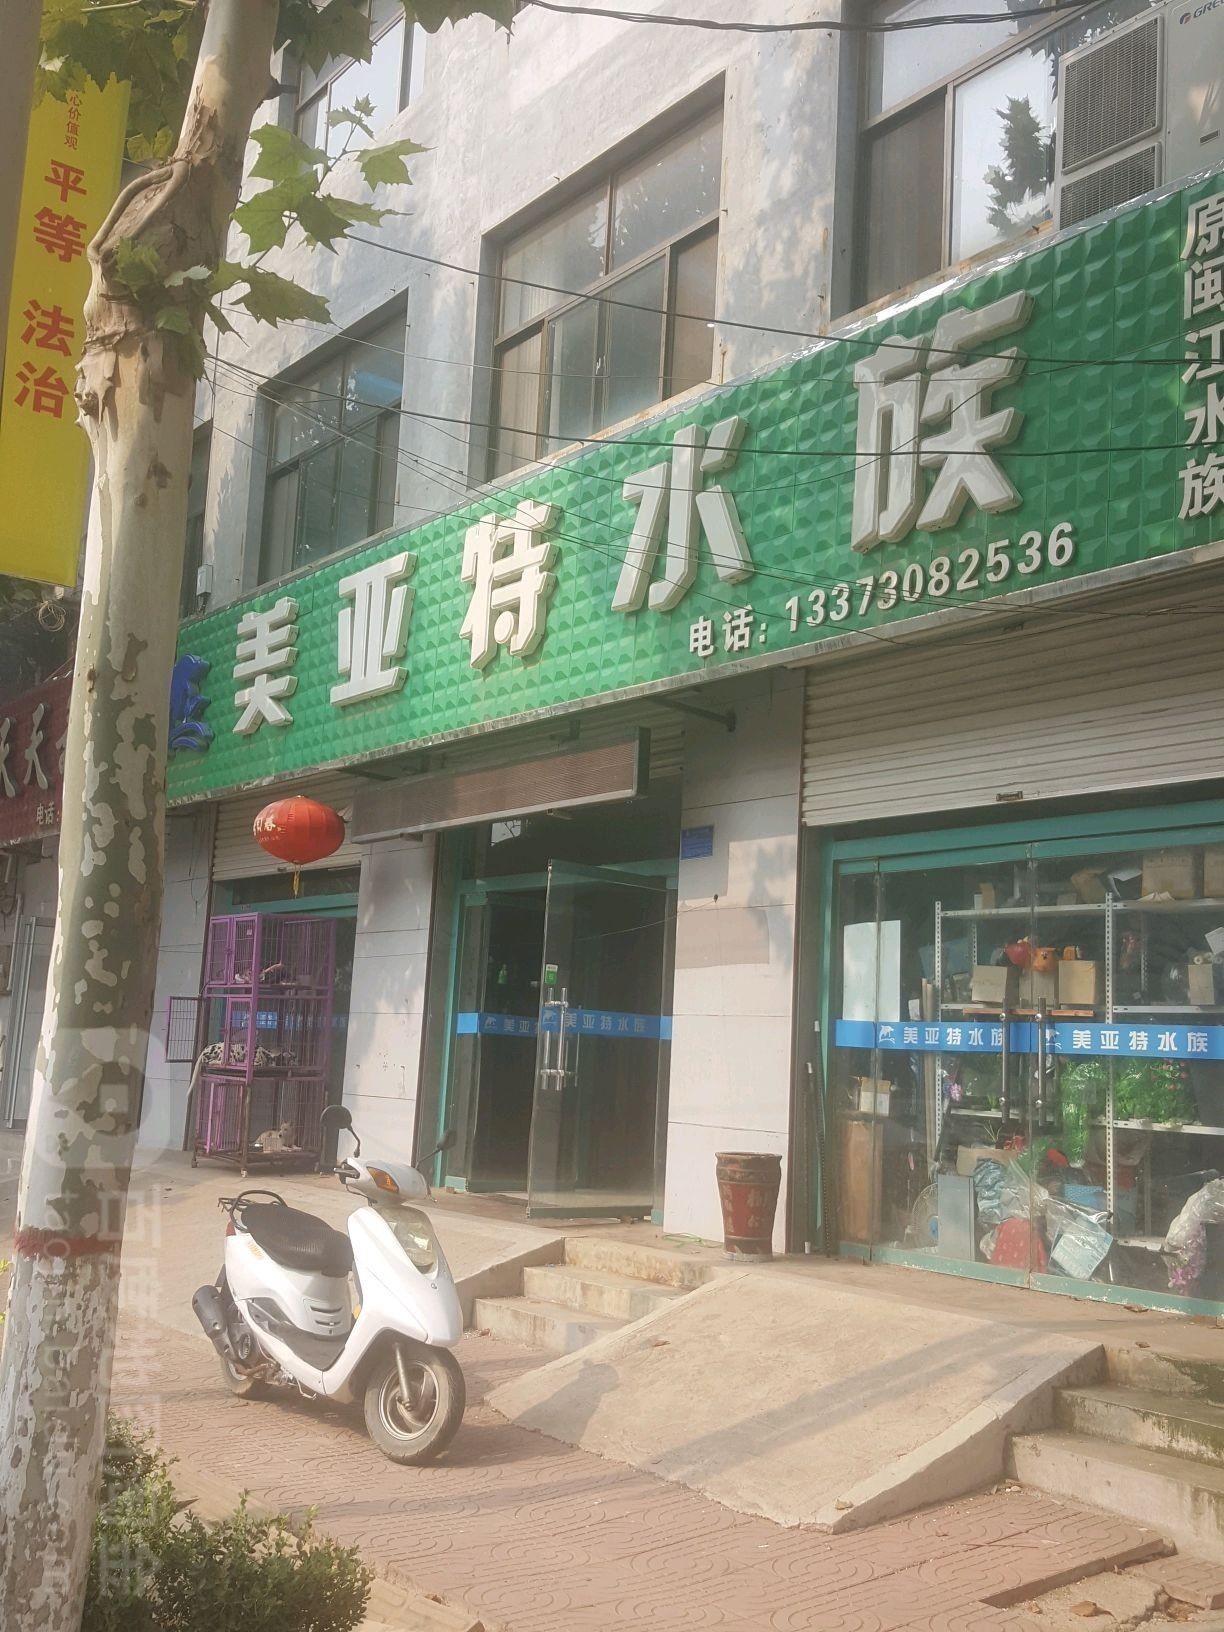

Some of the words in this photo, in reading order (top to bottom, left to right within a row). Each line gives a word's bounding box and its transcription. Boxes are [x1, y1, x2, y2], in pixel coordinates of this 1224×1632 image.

[33, 158, 88, 263] 平等
[14, 299, 75, 419] 法治
[232, 289, 1034, 737] 美亚特水族
[784, 521, 1075, 633] 13373082536
[1072, 1028, 1208, 1052] 美亚特水族
